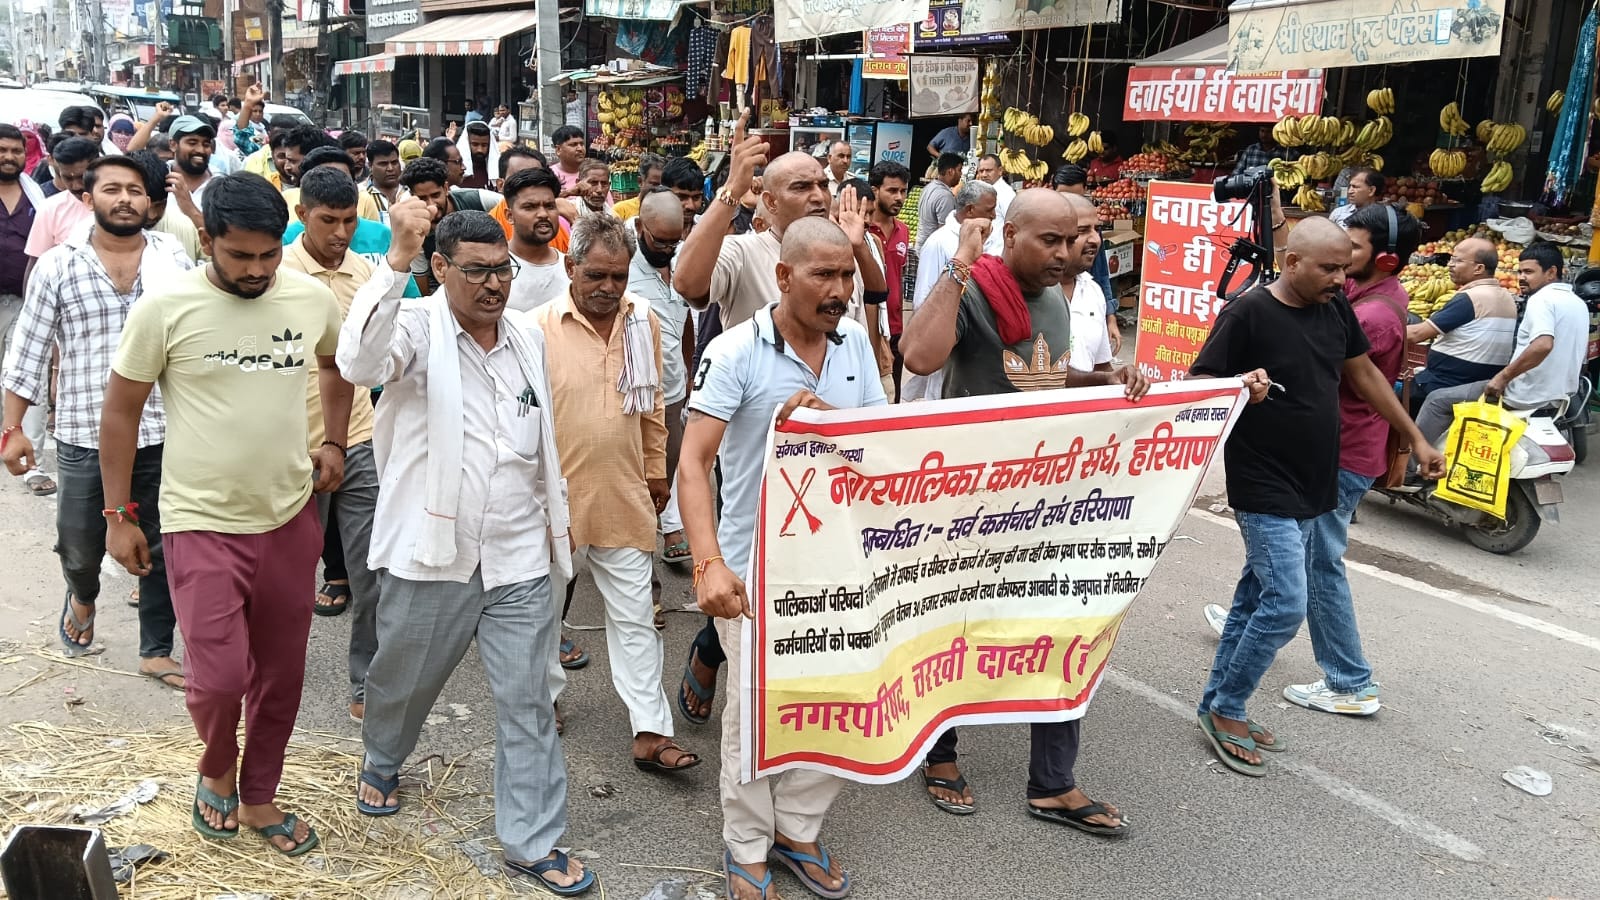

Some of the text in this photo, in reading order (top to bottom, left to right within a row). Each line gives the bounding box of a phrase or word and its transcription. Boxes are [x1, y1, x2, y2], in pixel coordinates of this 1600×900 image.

[1278, 10, 1300, 54] श्री
[1303, 20, 1350, 52] श्याम
[1203, 70, 1233, 112] ही
[882, 150, 906, 162] SURE
[1184, 235, 1216, 274] ही
[204, 349, 273, 372] adidas
[692, 358, 712, 391] 3
[828, 451, 987, 506] नगरपालिका
[986, 436, 1083, 493] कर्मचारी
[947, 506, 983, 541] सर्व
[978, 498, 1045, 537] कर्मचारी
[1070, 488, 1134, 525] हरियाणा
[774, 589, 828, 617] पालिकाओं
[889, 563, 898, 587] में
[897, 557, 921, 585] सफाई
[920, 562, 927, 578] व
[927, 553, 949, 578] सीवर
[949, 552, 960, 573] के
[959, 548, 981, 570] कार्य
[977, 546, 986, 568] में
[1003, 545, 1017, 566] की
[1016, 550, 1029, 564] जा
[1029, 541, 1045, 563] रही
[1043, 540, 1060, 560] ठेका
[1060, 544, 1076, 563] प्रथा
[1078, 543, 1089, 560] पर
[1089, 537, 1106, 560] रोक
[1137, 536, 1156, 559] सभी
[774, 627, 828, 656] कर्मचारियों
[829, 626, 846, 651] को
[847, 631, 874, 651] पक्का
[920, 594, 940, 616] हजार
[980, 583, 997, 600] तथा
[1059, 573, 1070, 596] के
[1072, 578, 1102, 605] अनुपात
[1103, 572, 1112, 595] में
[1112, 570, 1140, 594] नियमित
[976, 635, 1054, 680] दादरी
